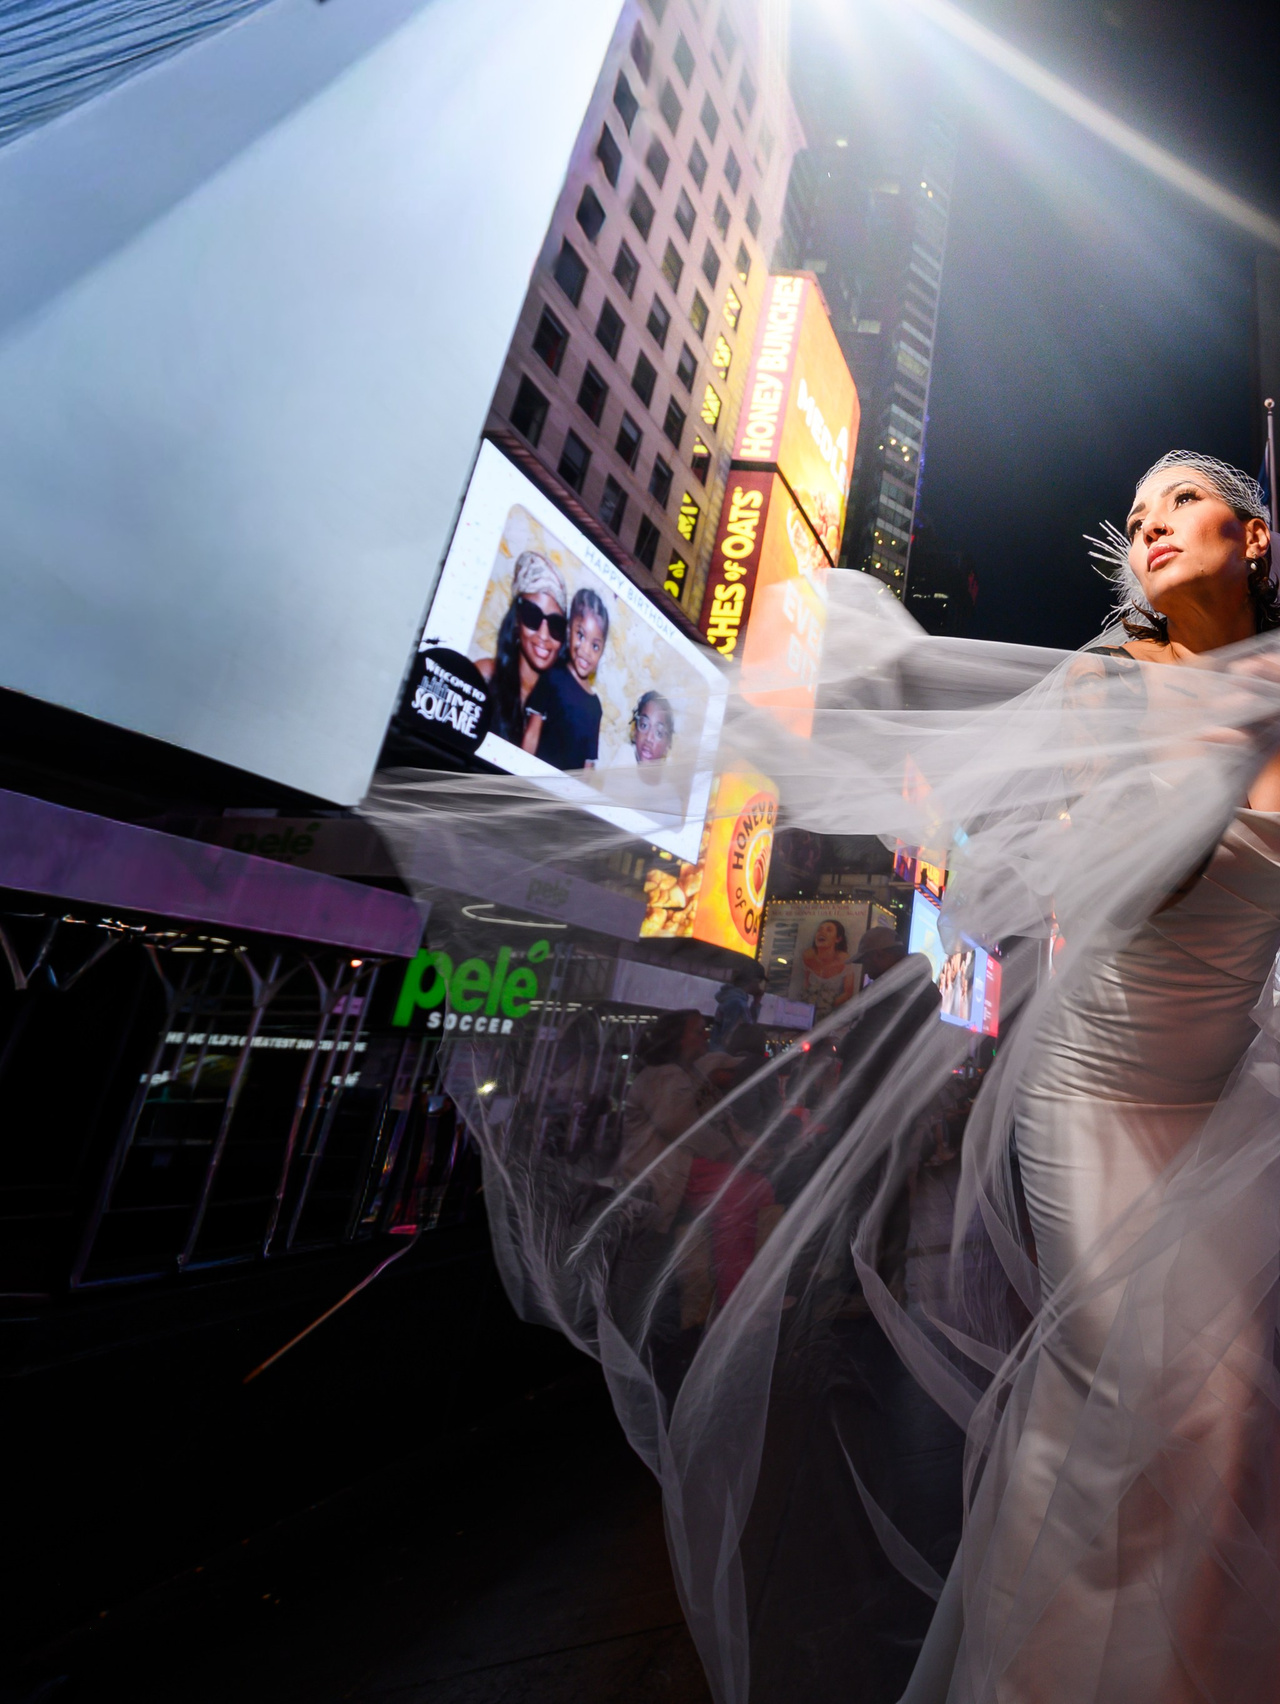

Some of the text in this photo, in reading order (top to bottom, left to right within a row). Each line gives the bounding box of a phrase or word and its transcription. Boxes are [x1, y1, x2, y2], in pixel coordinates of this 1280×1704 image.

[740, 373, 784, 458] HONEY
[585, 547, 676, 638] HAPPY BIRTHDAY
[706, 489, 764, 662] CHES of OATS
[425, 657, 487, 702] WELCOME TO
[446, 688, 483, 719] TIMES
[411, 687, 479, 739] SQUARE
[732, 801, 767, 870] HONEY
[735, 887, 747, 909] of
[391, 938, 550, 1027] pelé
[427, 1011, 514, 1035] SOCCER
